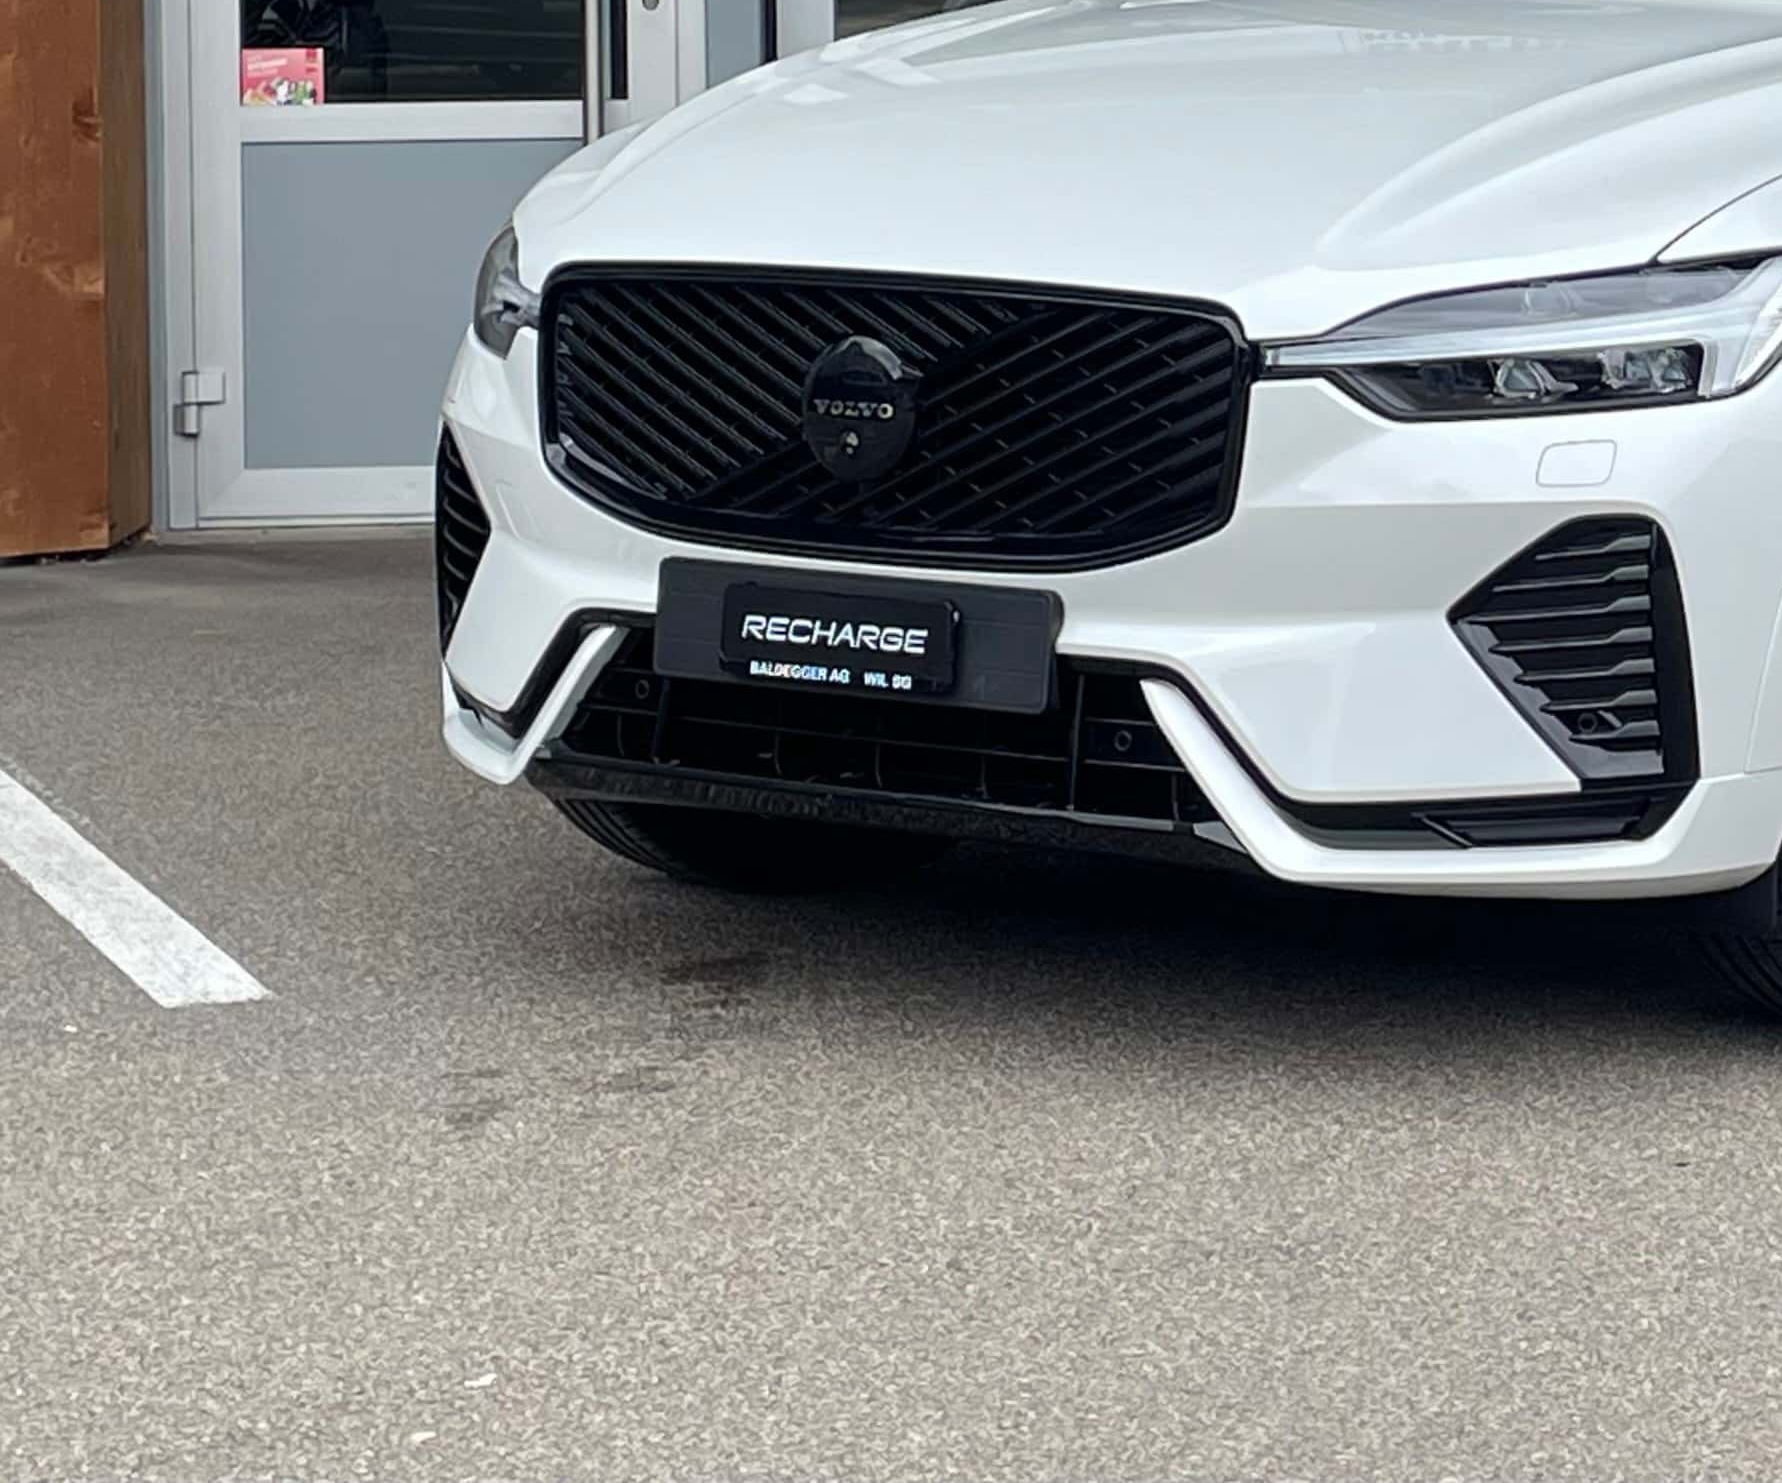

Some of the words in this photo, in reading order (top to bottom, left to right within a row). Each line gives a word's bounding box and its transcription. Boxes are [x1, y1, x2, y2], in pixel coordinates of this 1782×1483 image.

[812, 398, 895, 420] VOLVO
[740, 614, 929, 655] RECHARGE
[749, 659, 827, 681] BALDEGGER
[829, 668, 851, 684] AG
